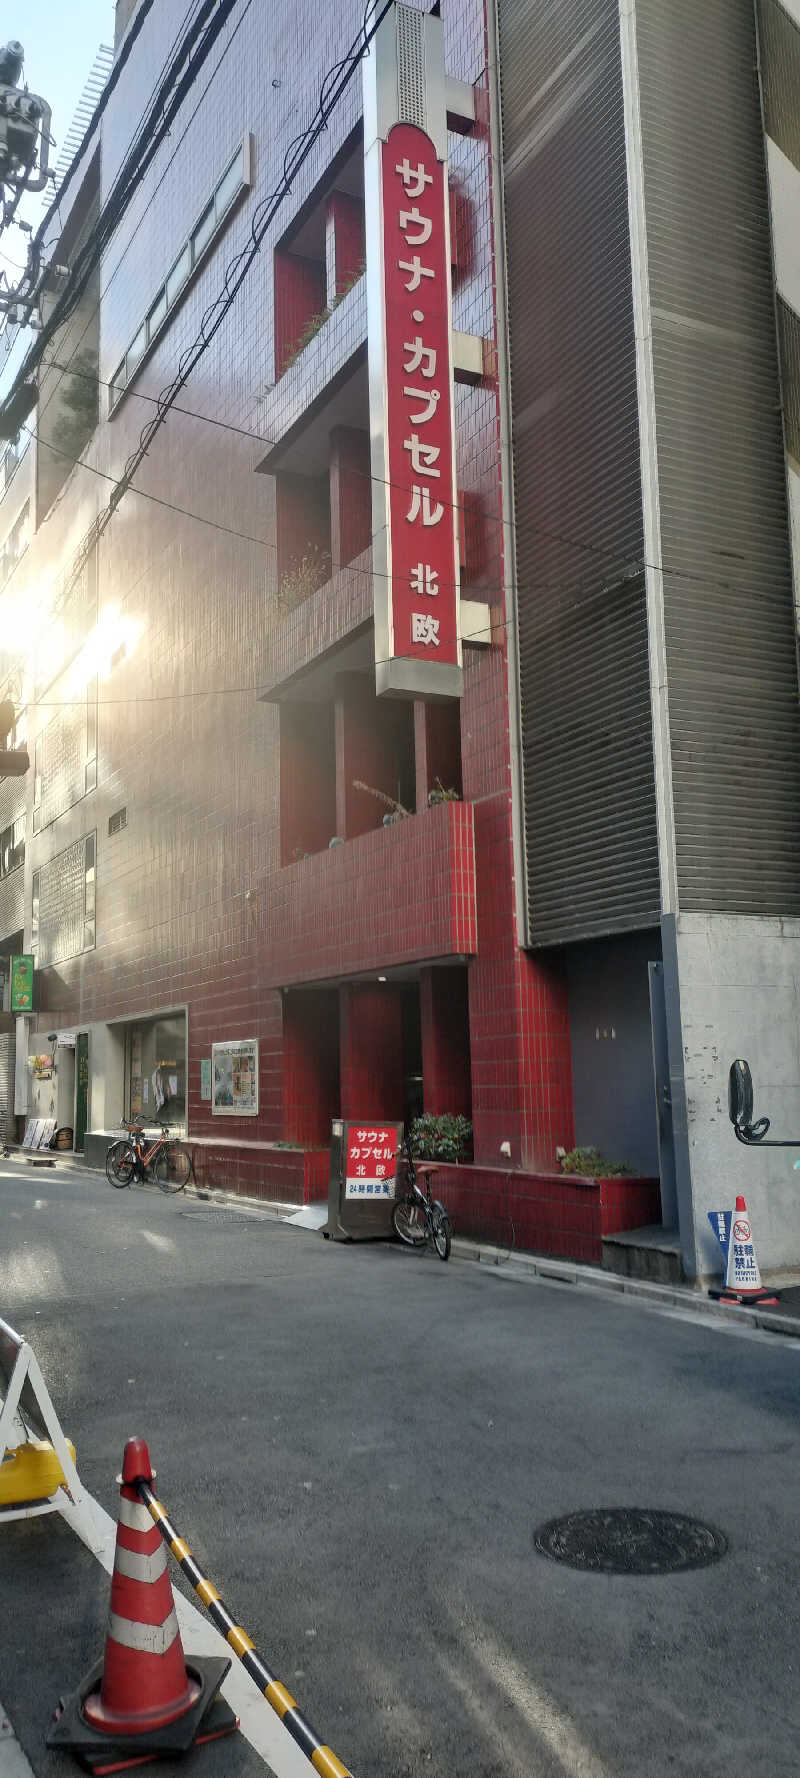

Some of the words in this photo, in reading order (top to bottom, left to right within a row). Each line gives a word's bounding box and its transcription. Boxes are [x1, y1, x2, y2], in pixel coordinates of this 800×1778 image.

[395, 158, 445, 526] サウナ・カプセル
[410, 563, 440, 646] 北欧
[357, 1131, 389, 1143] サウナ
[350, 1147, 393, 1160] カプセル
[349, 1184, 389, 1194] 24時間営業
[735, 1257, 756, 1269] 禁止
